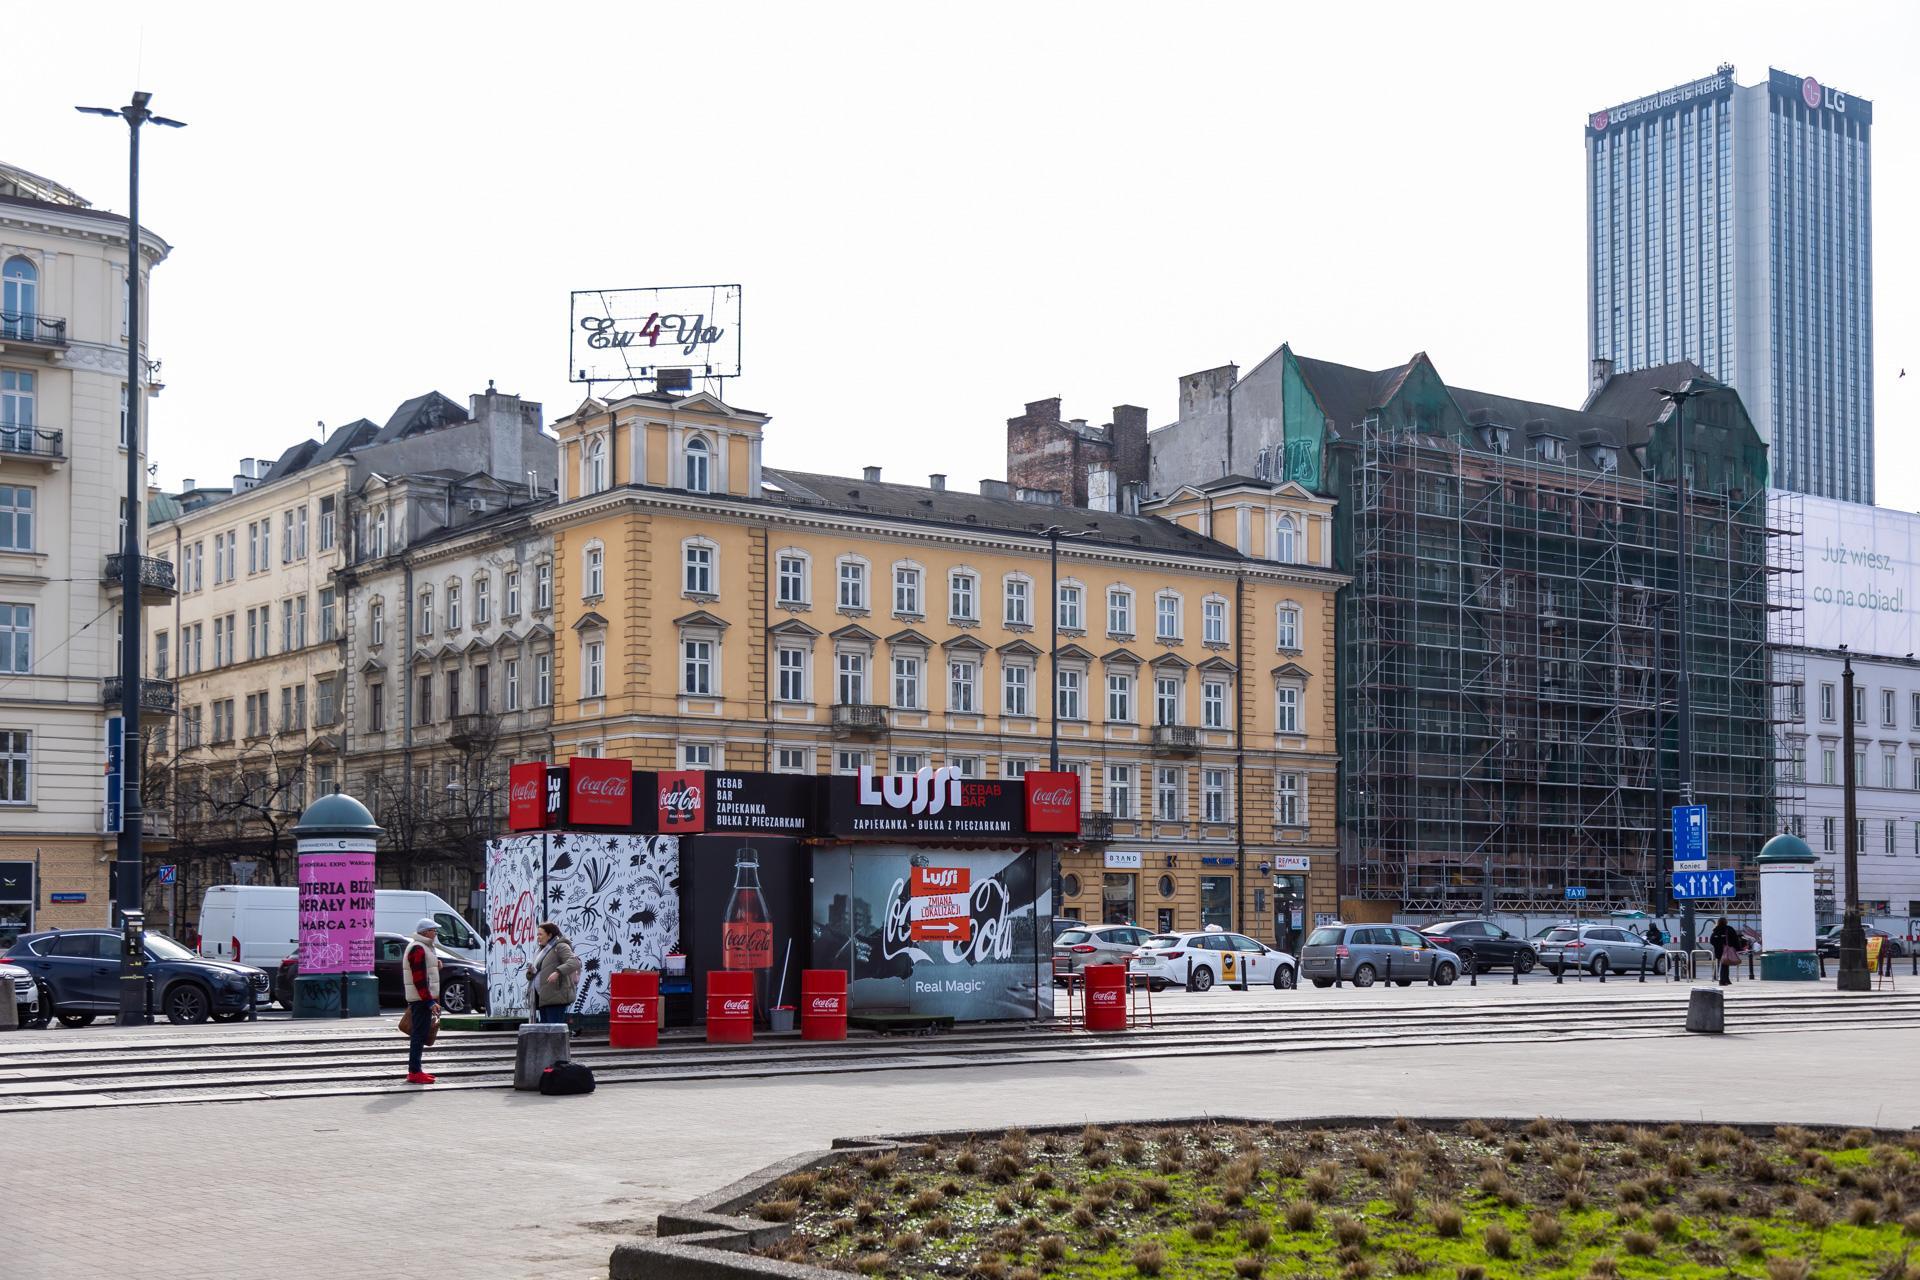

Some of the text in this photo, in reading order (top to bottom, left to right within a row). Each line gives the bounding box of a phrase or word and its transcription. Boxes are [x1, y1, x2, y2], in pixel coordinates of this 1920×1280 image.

[1609, 77, 1726, 125] LG FUTURE IS HERE
[1824, 87, 1846, 113] LG
[1821, 536, 1895, 576] Już wiesz,
[1813, 583, 1903, 613] co na obiad!
[716, 777, 743, 789] KEBAB
[716, 790, 733, 801] BAR
[961, 784, 1001, 796] KEBAB
[961, 796, 986, 807] BAR
[716, 802, 766, 815] ZAPIEKANKA
[716, 815, 805, 829] BUŁKA Z PIECZARKAMI
[853, 819, 1011, 831] ZAPIEKANKA BUŁKA Z PIECZARKAMI
[1278, 857, 1300, 865] RE/MAX
[161, 868, 176, 882] TAXI
[1566, 887, 1585, 898] TAXI
[928, 895, 953, 907] ZMIANA
[921, 904, 961, 918] LOKALIZACJI
[302, 920, 346, 931] MARCA
[349, 918, 368, 929] 2-3
[915, 980, 942, 993] Real
